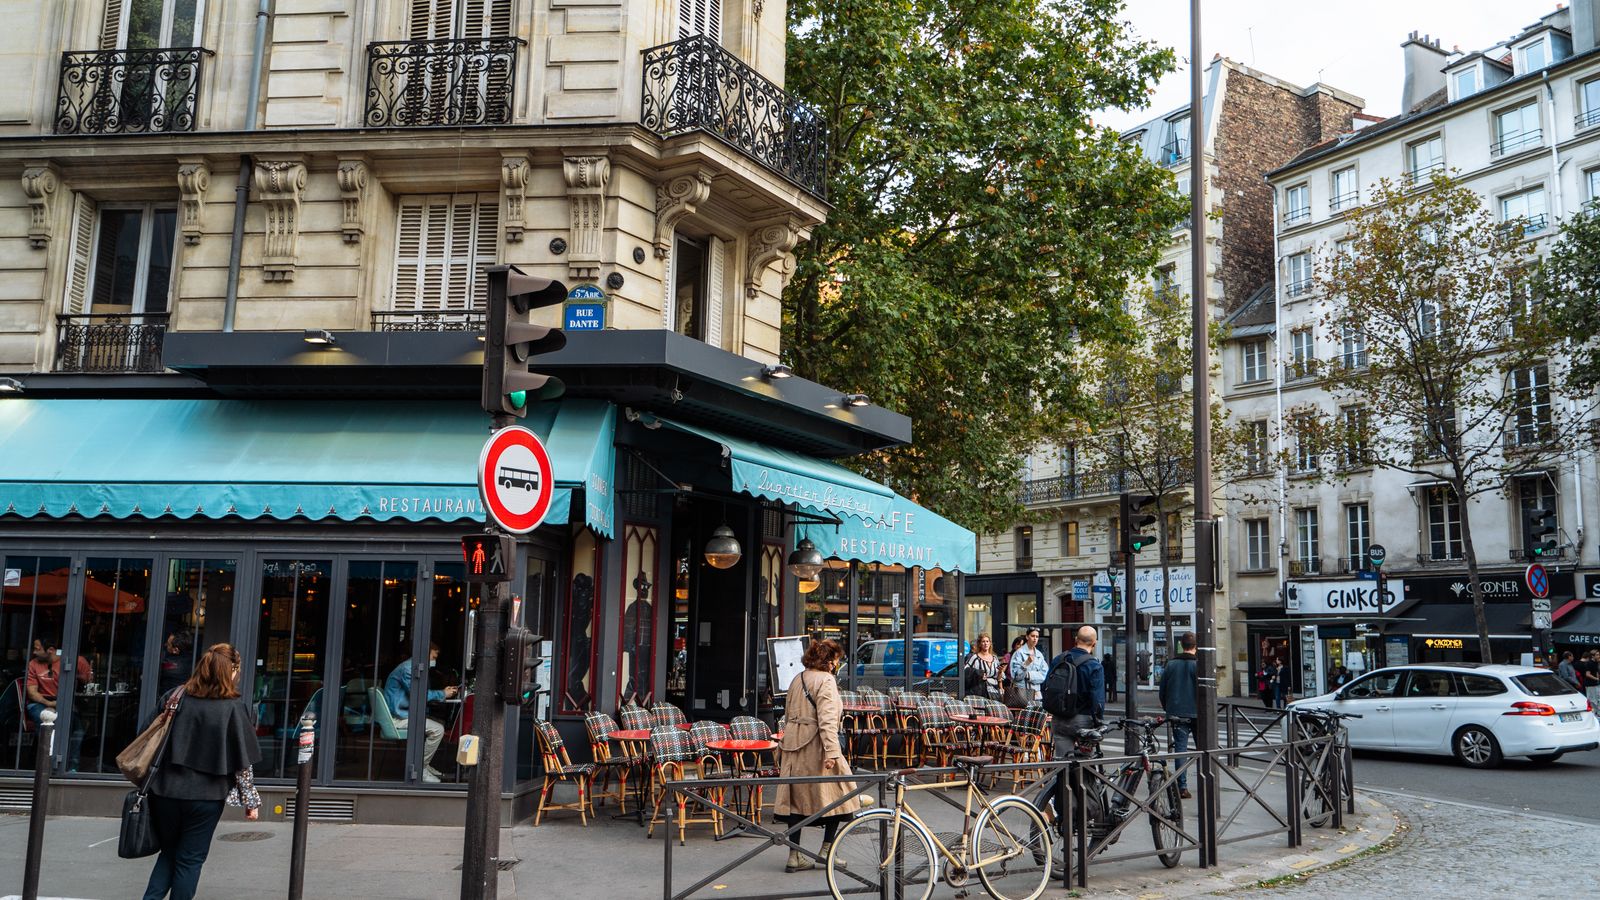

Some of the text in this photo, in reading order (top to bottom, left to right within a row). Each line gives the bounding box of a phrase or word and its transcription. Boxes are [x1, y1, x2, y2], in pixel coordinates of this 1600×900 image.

[576, 309, 594, 317] RUE
[570, 320, 599, 328] DANTE
[841, 537, 933, 562] RESTAURANT
[1152, 571, 1191, 582] Gemain
[1466, 581, 1519, 594] COONER
[1155, 586, 1193, 604] EOLE
[1433, 639, 1463, 647] CROONER
[1569, 634, 1600, 644] CAFE C
